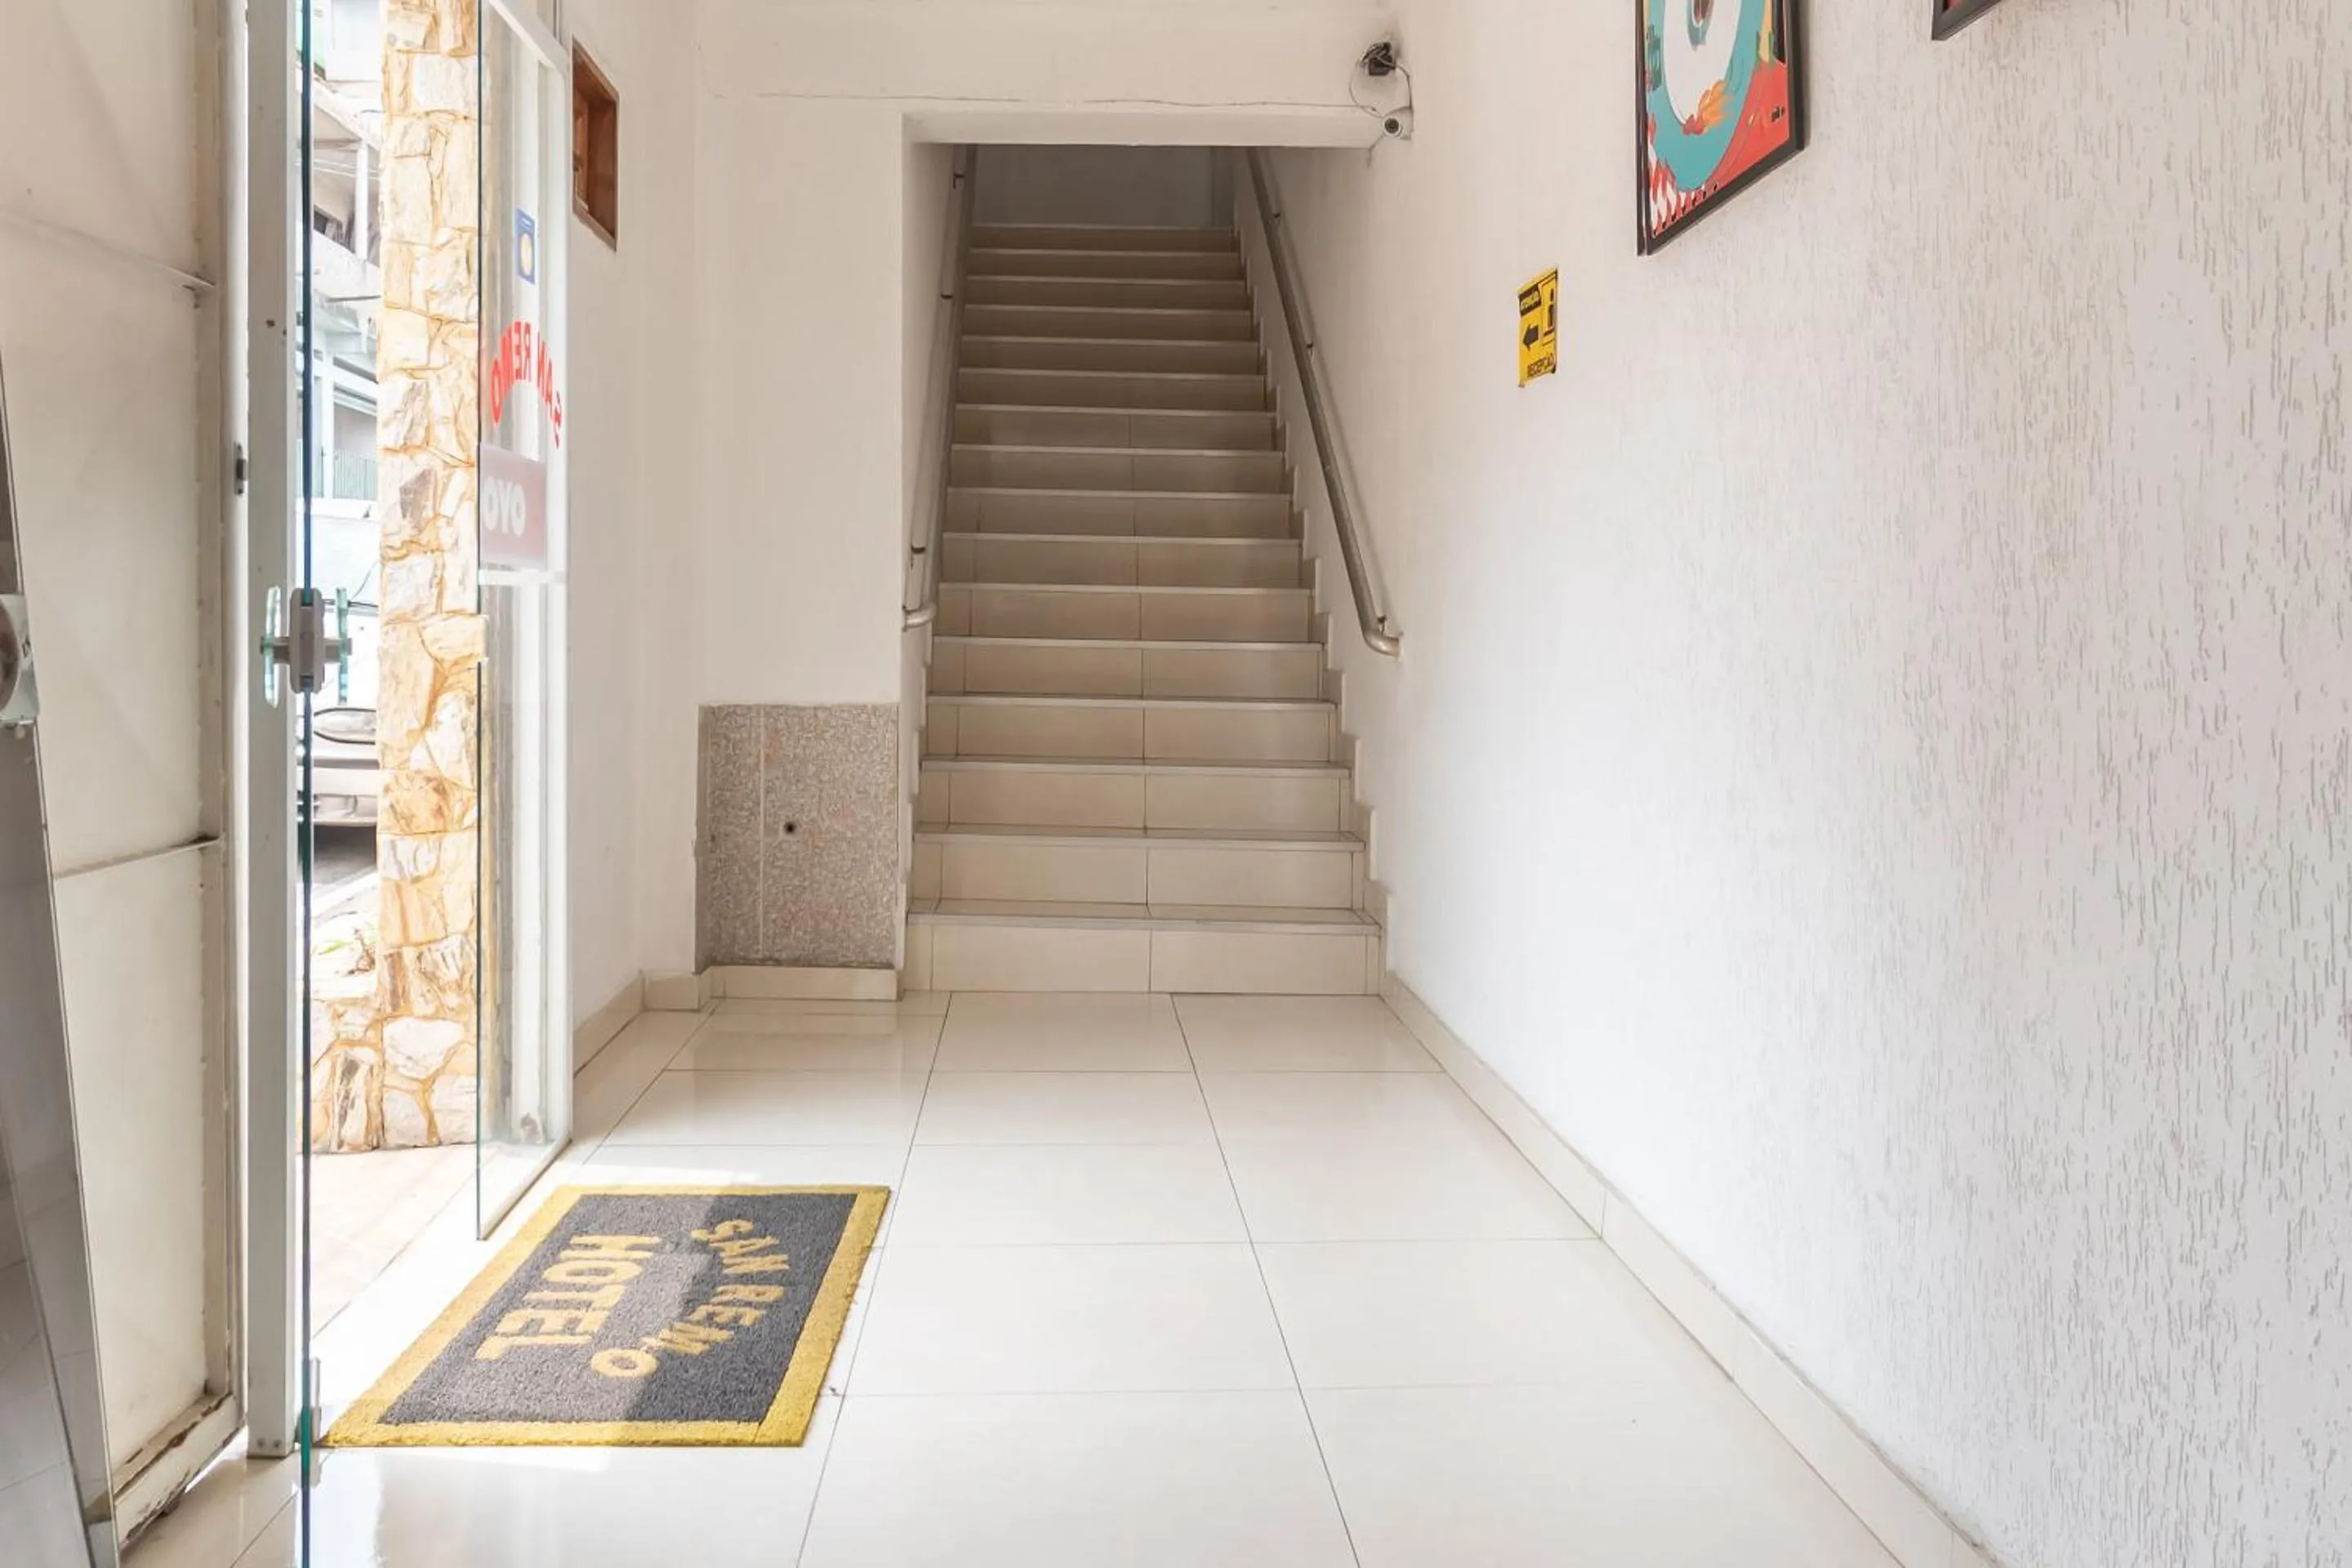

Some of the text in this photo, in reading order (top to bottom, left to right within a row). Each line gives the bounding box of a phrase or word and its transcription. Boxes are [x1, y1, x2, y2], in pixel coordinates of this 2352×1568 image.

[475, 1235, 662, 1361] HOTEL
[590, 1219, 791, 1379] SAN REMO
